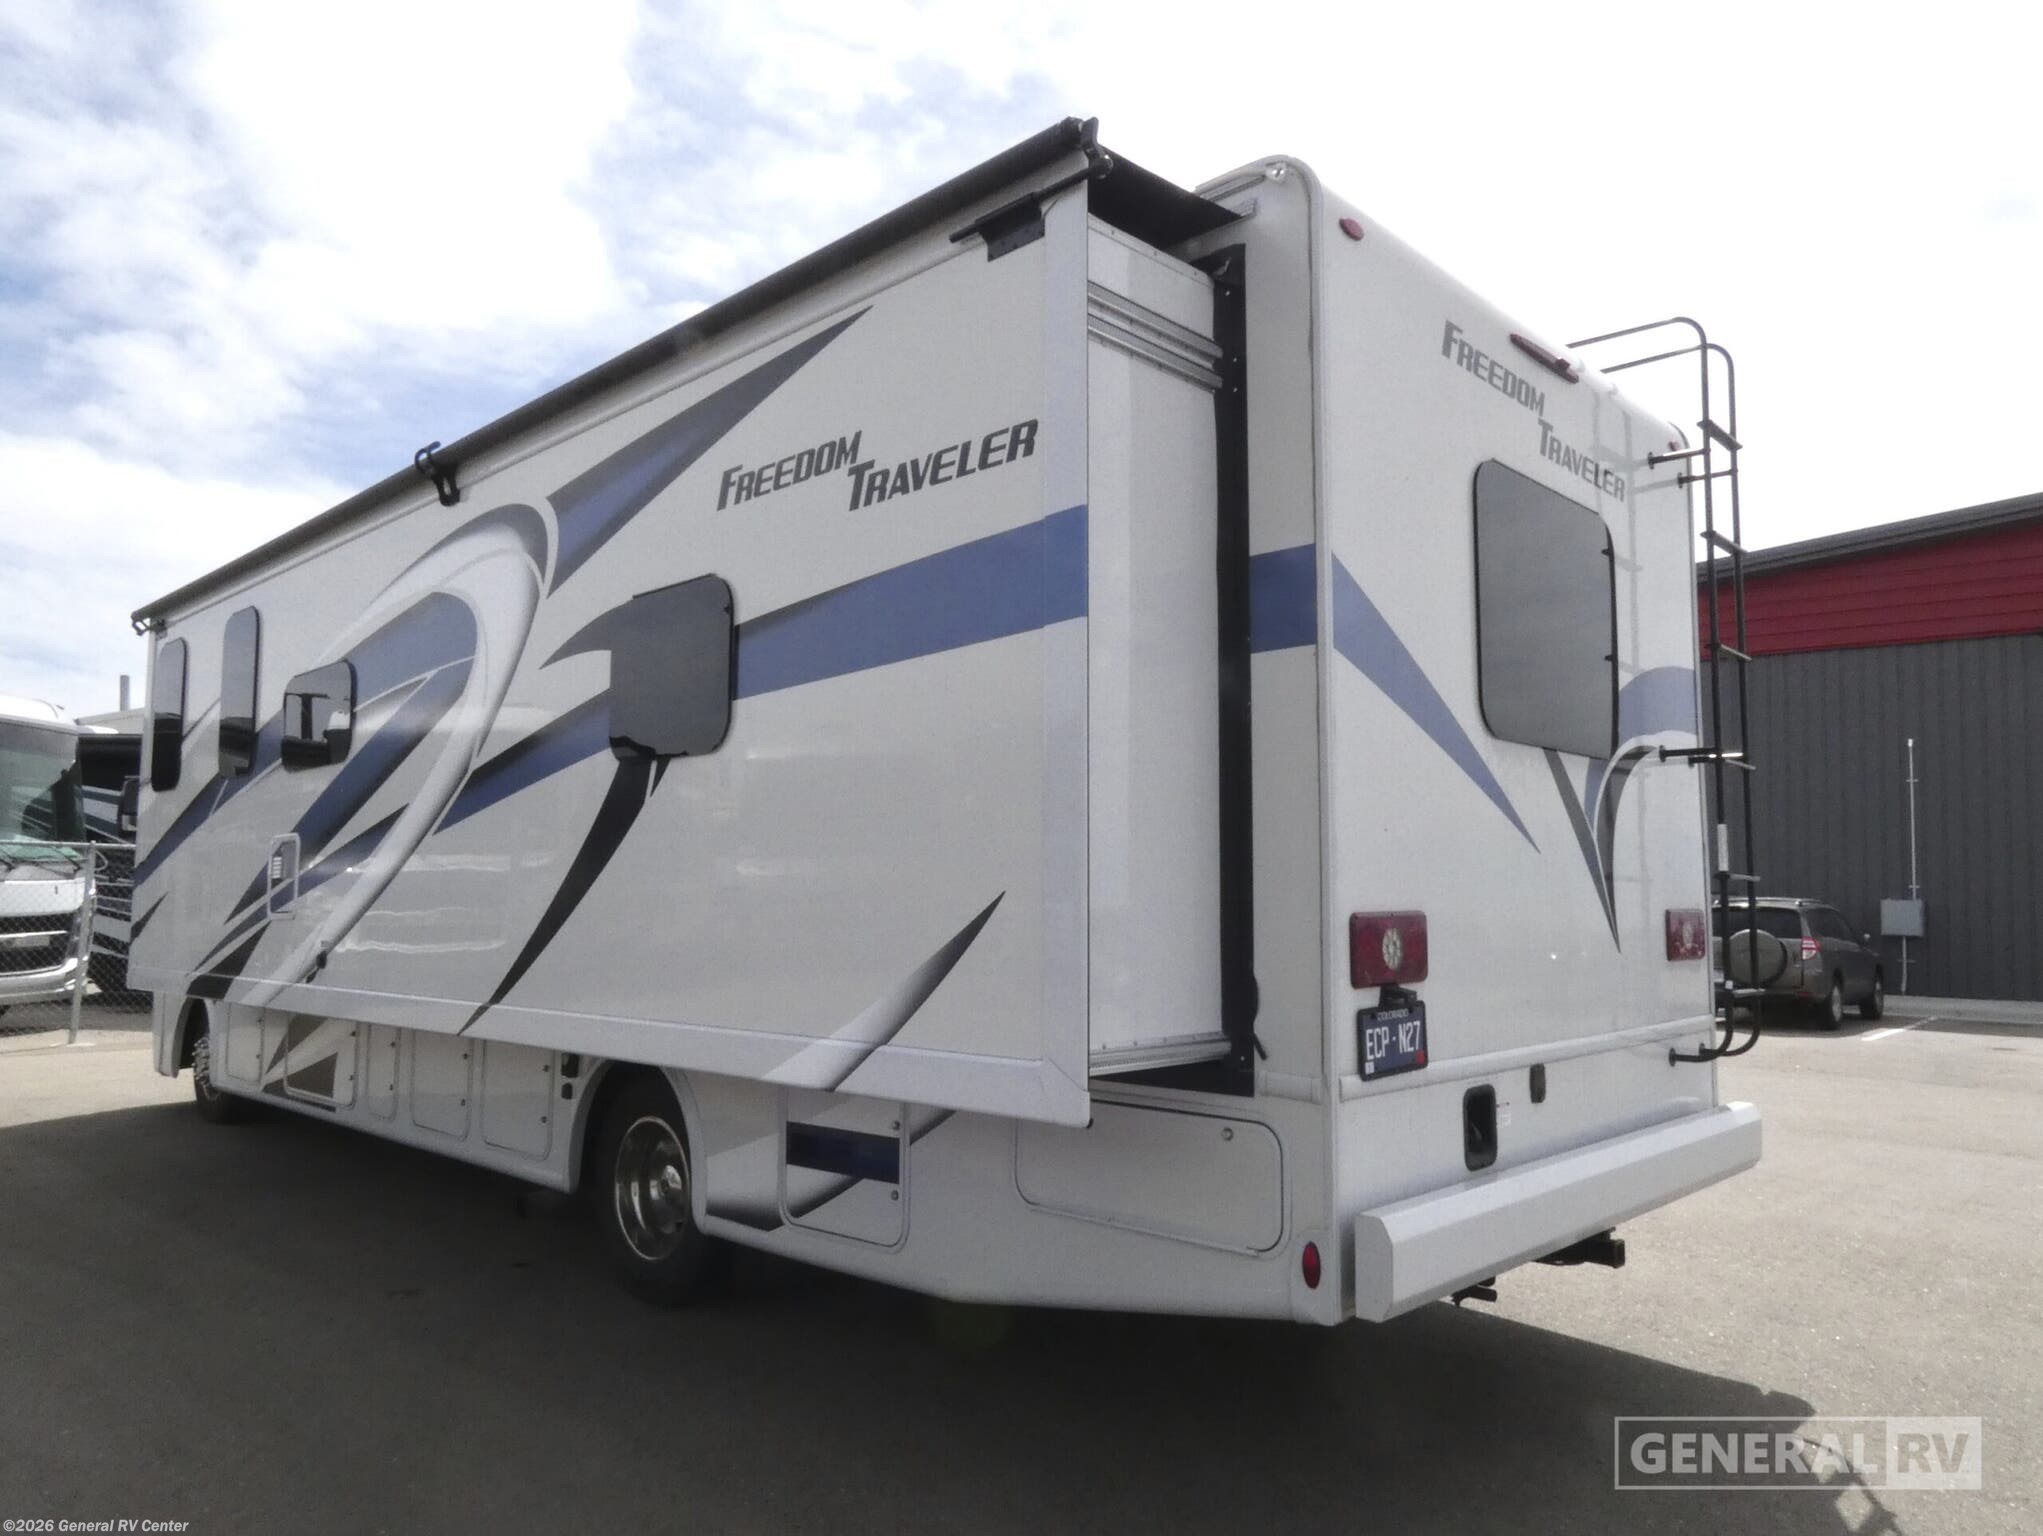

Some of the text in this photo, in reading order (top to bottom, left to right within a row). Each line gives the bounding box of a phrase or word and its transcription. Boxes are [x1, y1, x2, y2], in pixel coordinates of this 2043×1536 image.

[1441, 320, 1546, 417] FREEDOM
[717, 430, 862, 511] FREEDOM
[847, 418, 1039, 511] TRAVELER
[1538, 417, 1626, 502] TRAVELER
